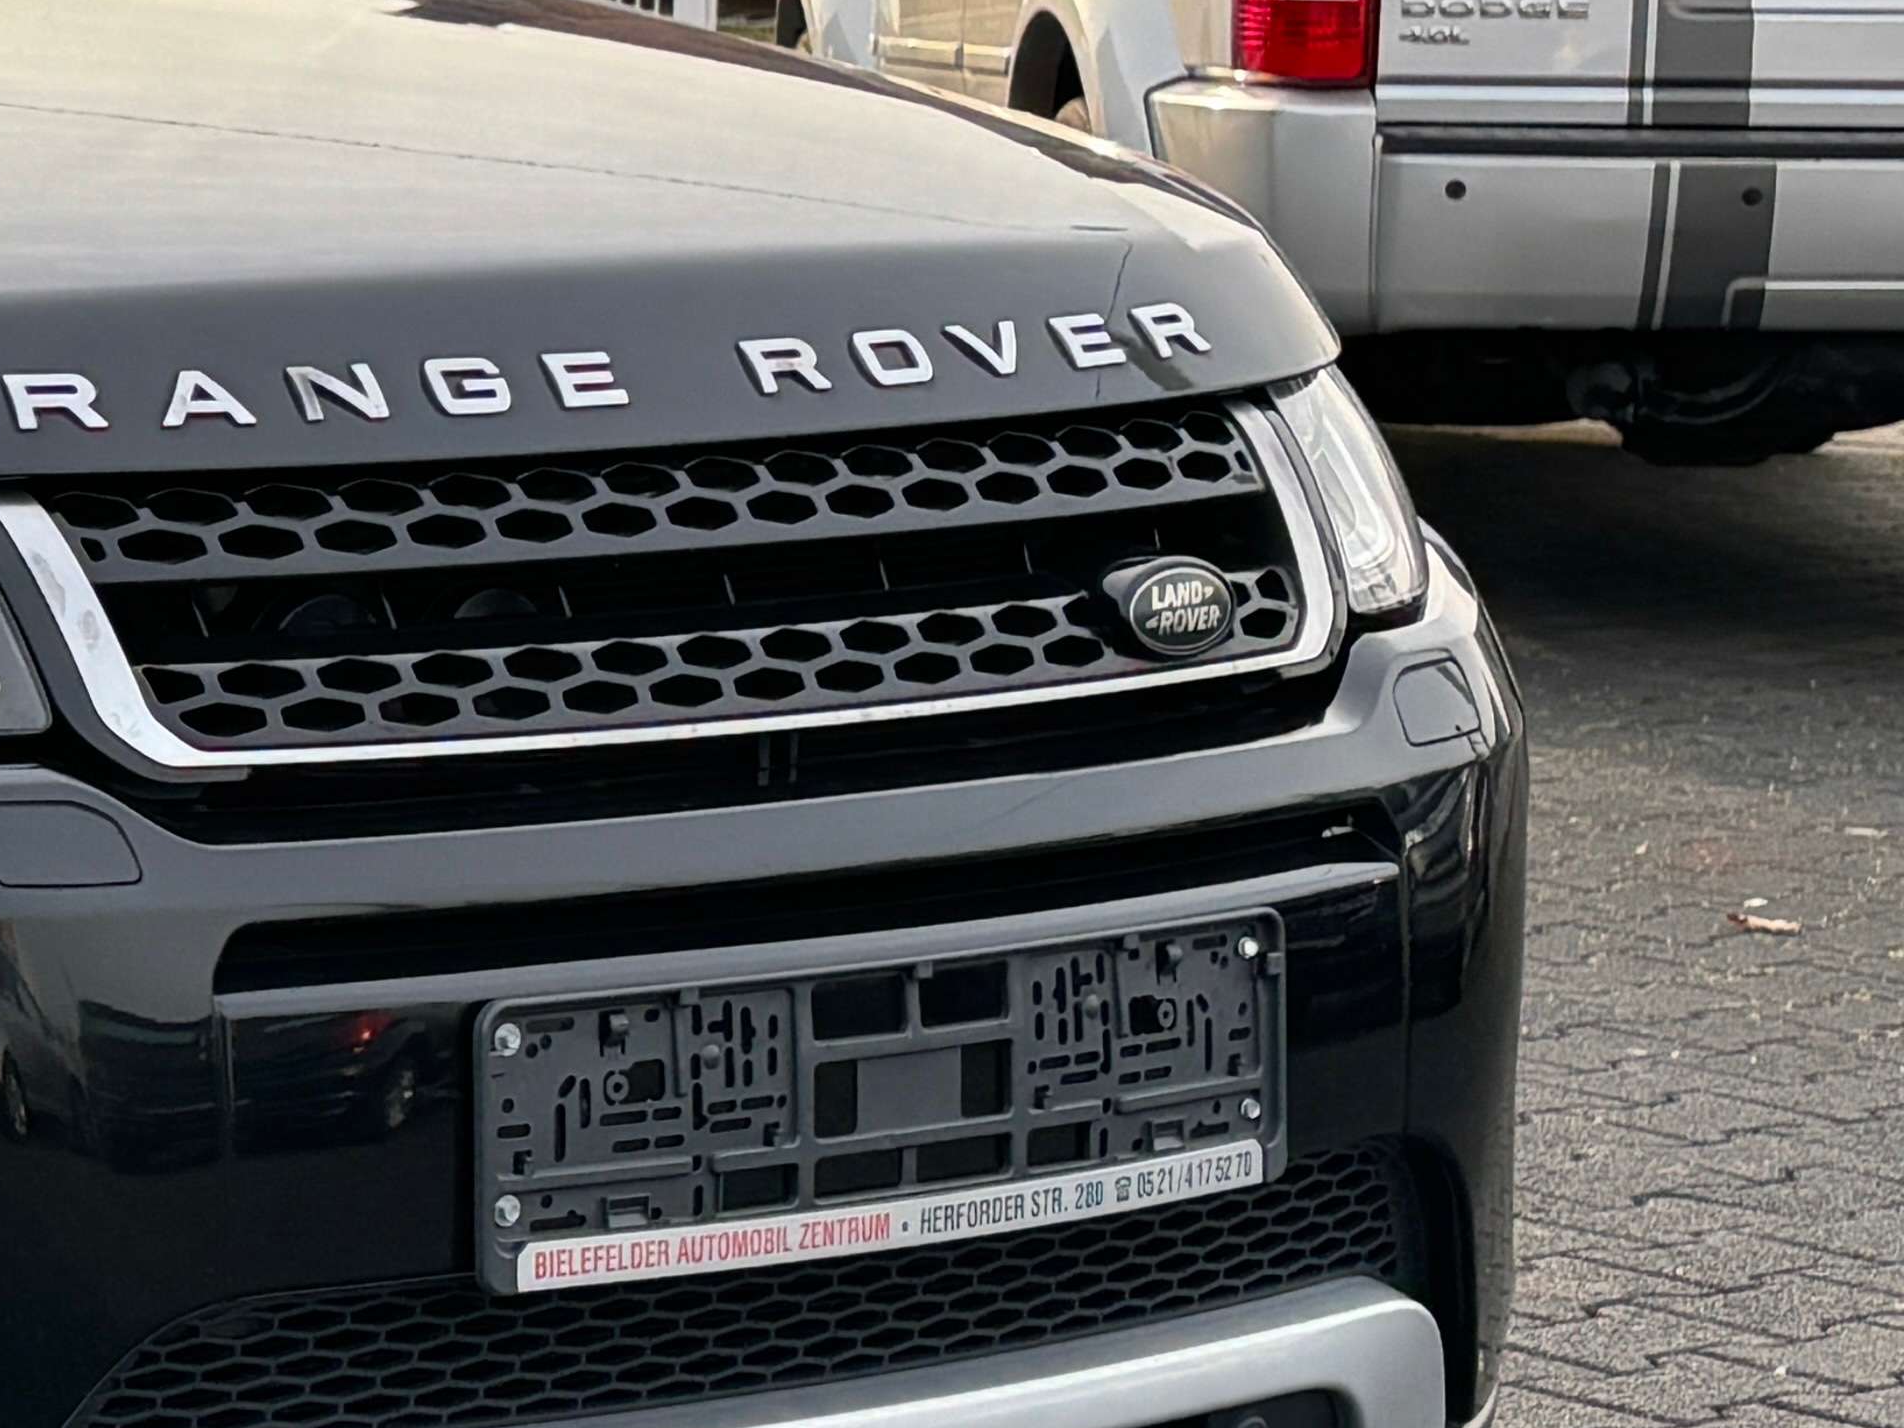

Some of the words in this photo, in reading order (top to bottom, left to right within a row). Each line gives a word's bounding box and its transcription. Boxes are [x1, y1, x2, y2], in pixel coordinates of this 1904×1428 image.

[0, 350, 630, 432] RANGE
[738, 299, 1214, 396] ROVER
[1152, 580, 1204, 611] LAND
[1158, 604, 1222, 636] ROVER
[534, 1239, 670, 1280] BIELEFELDER
[677, 1226, 793, 1266] AUTOMOBIL
[799, 1212, 892, 1251] ZENTRUM
[920, 1193, 1025, 1236] HERFORDER
[1031, 1187, 1069, 1218] STR.
